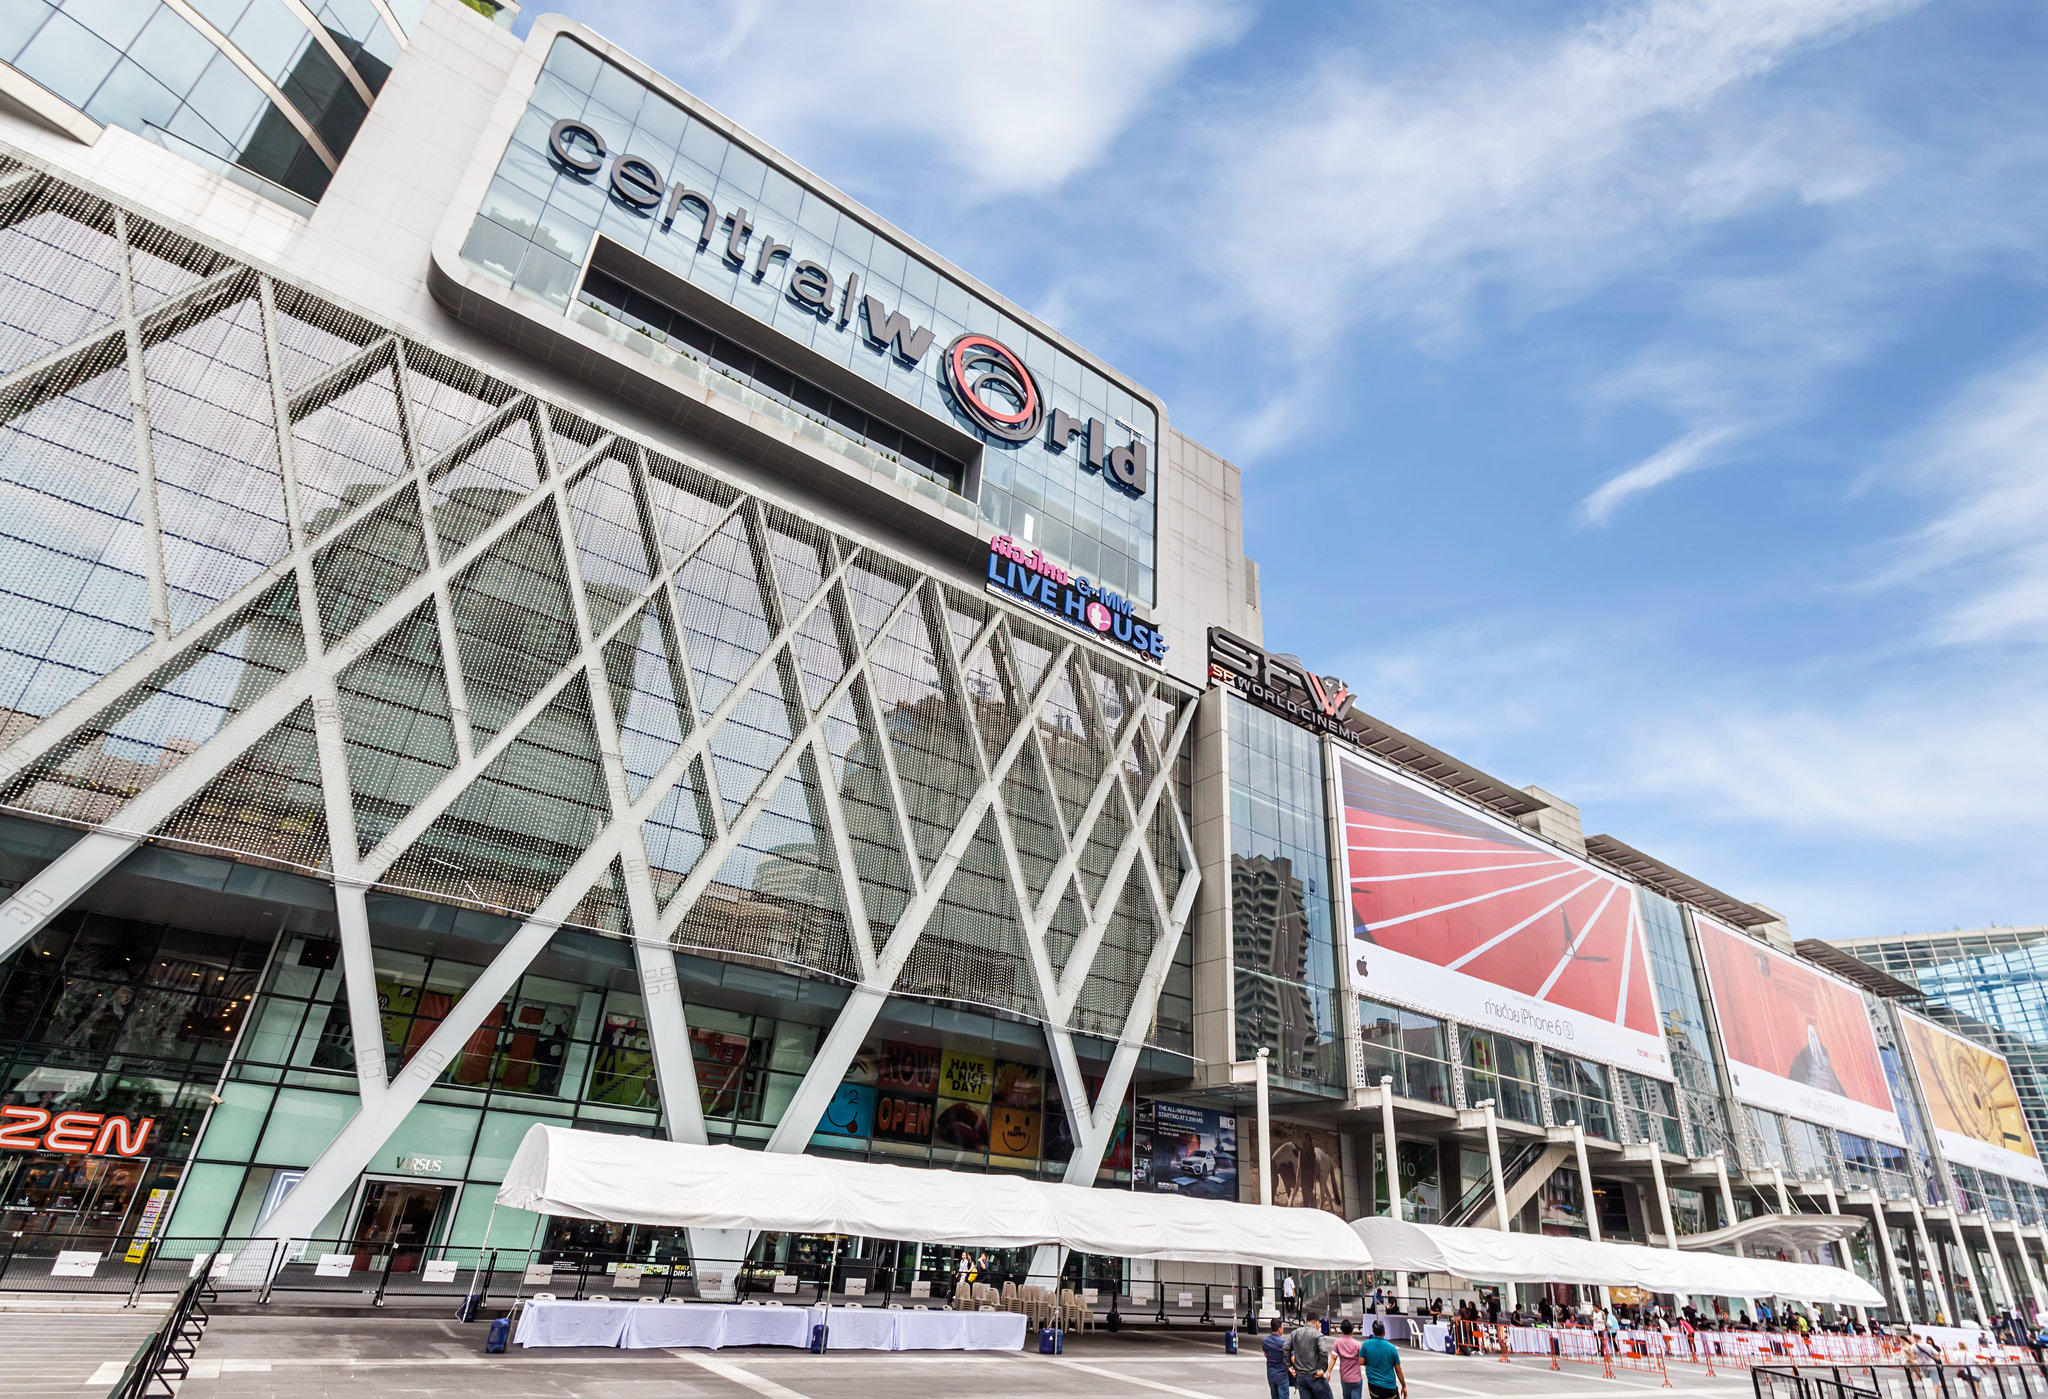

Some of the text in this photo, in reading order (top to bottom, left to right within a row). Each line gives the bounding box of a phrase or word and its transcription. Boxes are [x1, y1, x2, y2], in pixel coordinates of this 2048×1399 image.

[990, 535, 1068, 586] เมืองไทย
[988, 552, 1058, 607] LIVE
[1209, 664, 1360, 743] SF WORLD CINEMA
[1521, 1008, 1554, 1034] iPhone
[945, 1069, 988, 1085] A NICE
[950, 1058, 985, 1074] HAVE
[951, 1080, 982, 1095] DAY!
[878, 1097, 931, 1136] OPEN
[0, 1105, 155, 1157] ZEN
[1007, 1131, 1026, 1139] HAPPY
[396, 1156, 442, 1173] VERSUS
